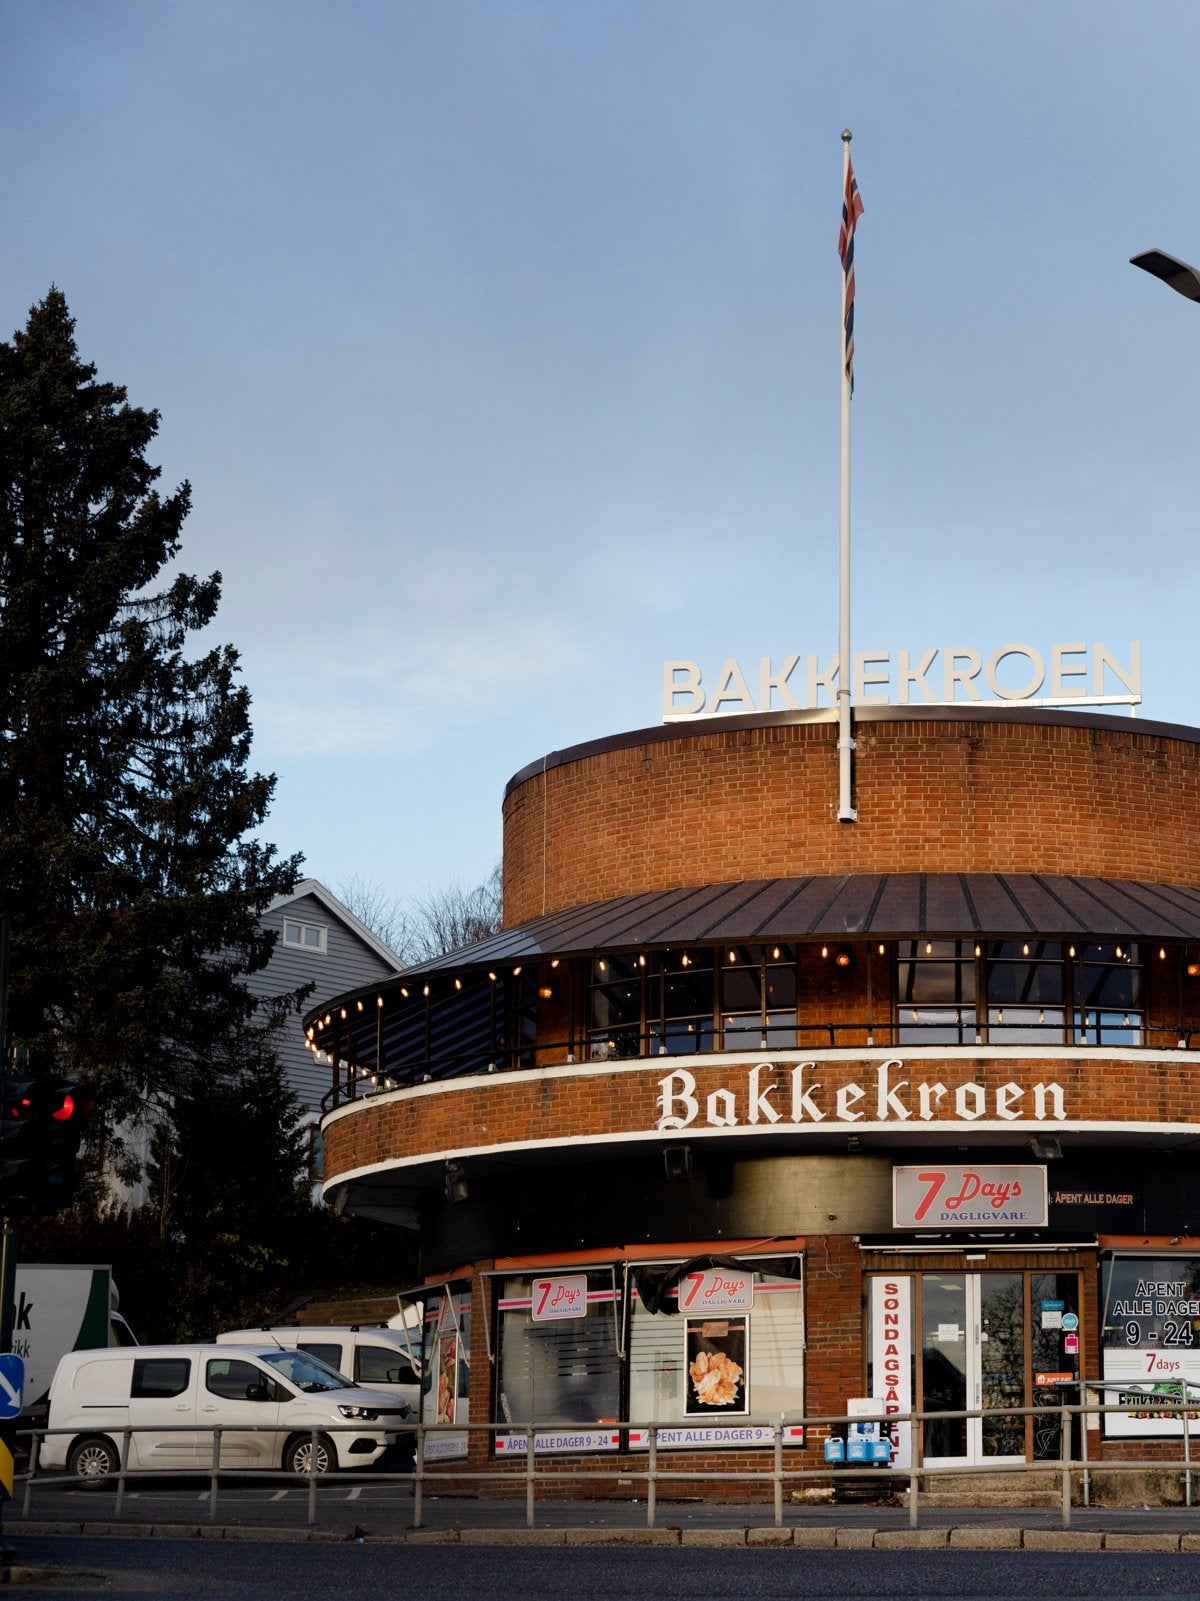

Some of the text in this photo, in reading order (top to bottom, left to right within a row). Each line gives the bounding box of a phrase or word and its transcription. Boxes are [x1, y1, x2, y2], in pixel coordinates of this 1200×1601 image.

[663, 640, 1141, 714] BAKKEKROEN
[657, 1060, 1067, 1131] Bakkekroen
[914, 1172, 1023, 1221] 7 Days
[1055, 1191, 1083, 1204] ÅPENT
[1084, 1194, 1104, 1204] ALLE
[1106, 1194, 1133, 1204] DAGER
[940, 1211, 1027, 1221] DAGLIGVARE
[536, 1283, 581, 1316] 7 Days
[684, 1273, 745, 1307] 7 Days
[1135, 1279, 1186, 1297] ÅPENT
[13, 1292, 34, 1330] k
[1113, 1301, 1153, 1316] ALLE
[1126, 1321, 1141, 1345] 9
[1163, 1321, 1193, 1345] 24
[507, 1438, 528, 1451] ÅPEN
[535, 1437, 555, 1449] ALLE
[556, 1436, 585, 1448] DAGER
[586, 1436, 591, 1447] 9
[598, 1435, 608, 1446] 24
[685, 1429, 714, 1442] ALLE
[715, 1428, 754, 1441] DAGER
[755, 1428, 762, 1440] 9
